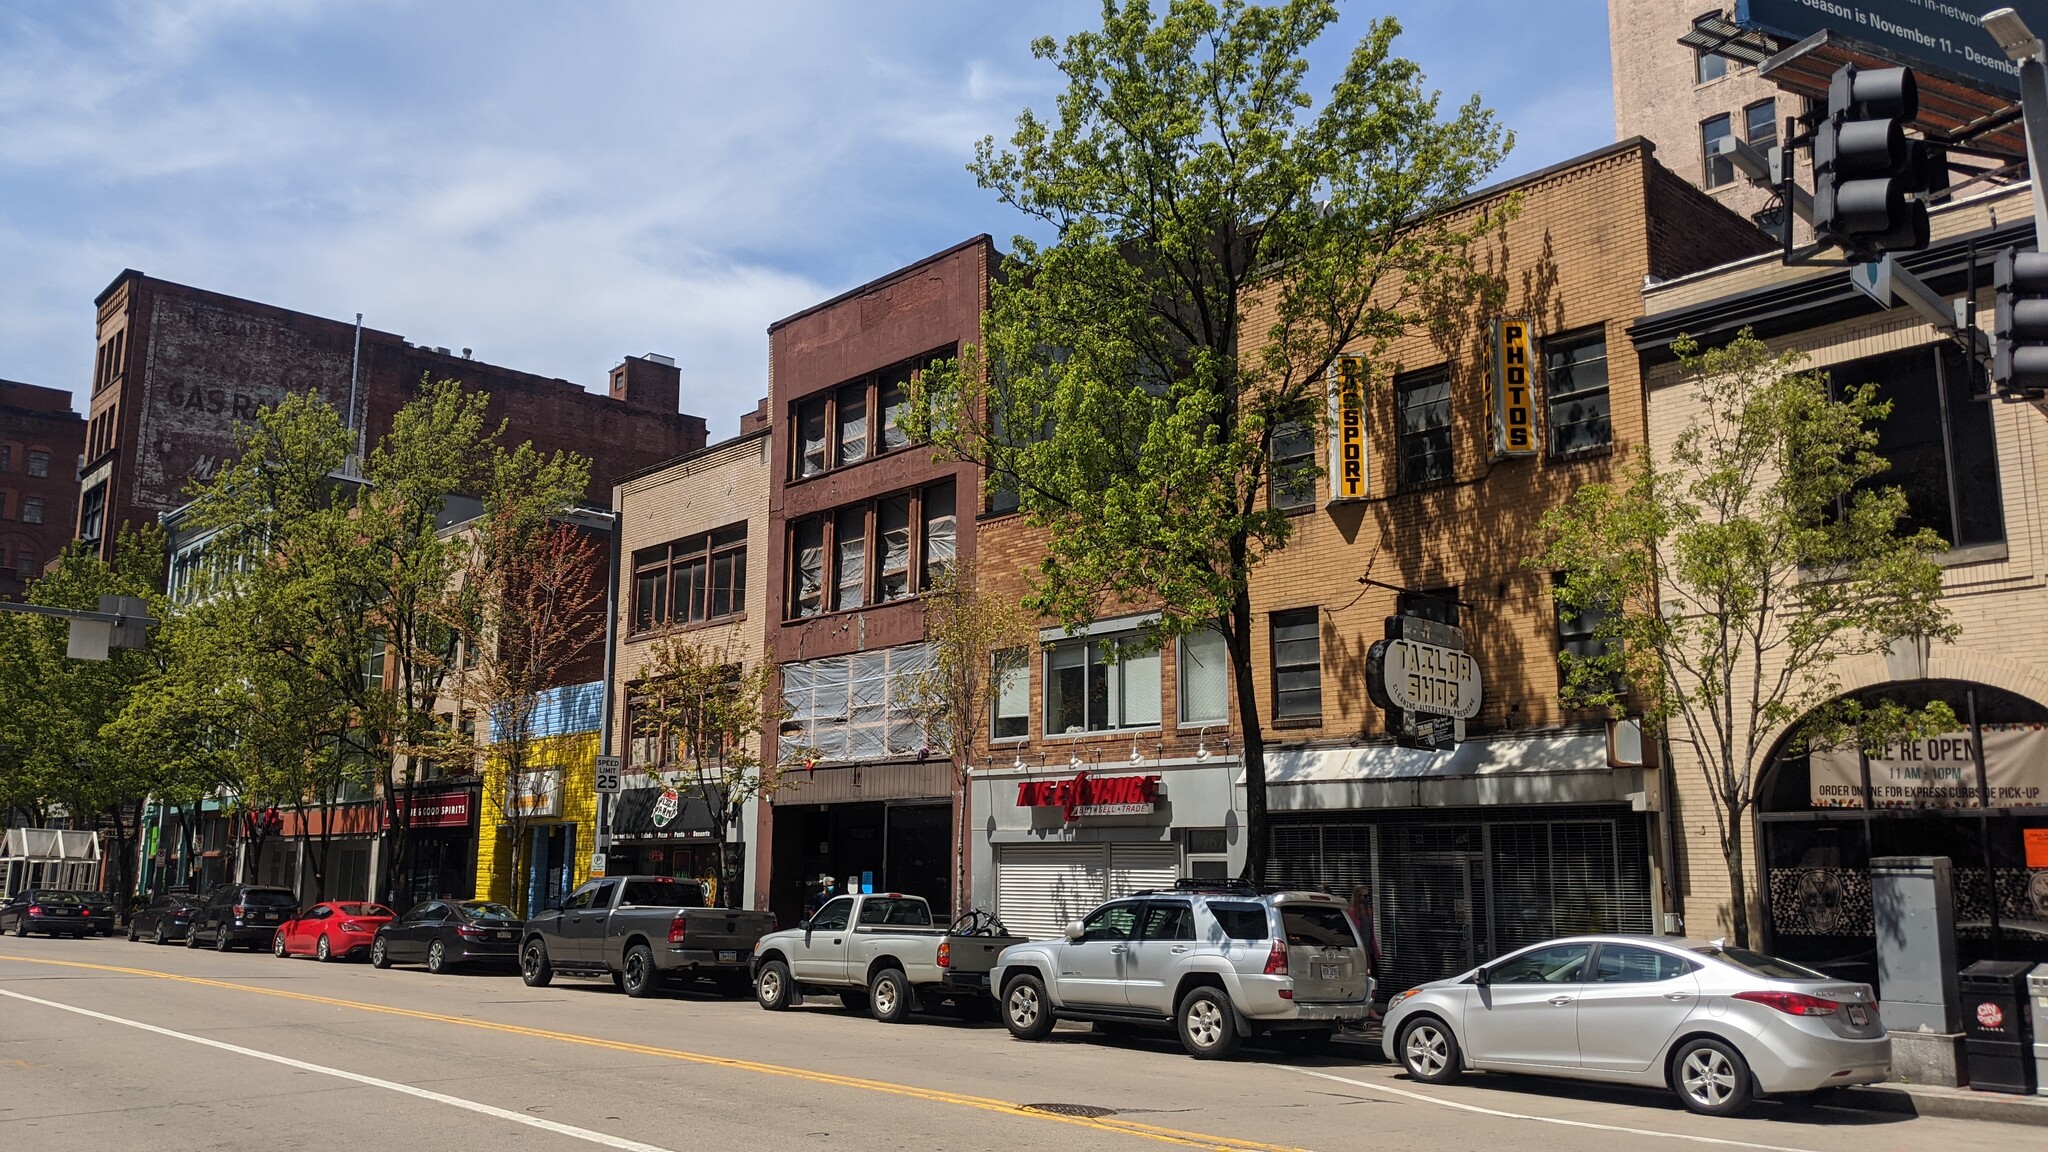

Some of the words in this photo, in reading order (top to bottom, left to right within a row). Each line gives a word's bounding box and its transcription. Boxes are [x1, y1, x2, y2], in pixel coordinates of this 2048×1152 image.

[1855, 8, 1866, 24] is
[1869, 13, 1936, 48] November
[1939, 38, 1952, 53] 11
[1964, 46, 2020, 77] Decembe
[167, 378, 226, 414] GAS
[1505, 326, 1528, 446] PHOTOS
[1341, 359, 1361, 495] PASSPORT
[1396, 641, 1472, 681] TAILOR
[1393, 684, 1416, 710] CLEANING
[1419, 704, 1450, 716] ALTERATION
[1454, 698, 1475, 717] PRESSING
[1408, 674, 1459, 708] SHOP
[1868, 739, 1923, 760] WERE
[597, 775, 618, 789] 25
[1890, 767, 1901, 779] 11
[1905, 767, 1920, 779] AM
[1933, 767, 1961, 779] 10PM
[1016, 781, 1056, 806] THE
[1820, 785, 1850, 796] ORDER
[1851, 786, 1883, 797] ONNE
[1885, 787, 1903, 797] FOR
[1905, 787, 1947, 798] EXPRESS
[1949, 787, 1996, 798] CURBSDE
[1999, 787, 2040, 799] PICK-UP
[423, 806, 439, 816] GOOD
[441, 805, 465, 815] SPIRITS
[1099, 806, 1116, 814] SELL
[1122, 805, 1146, 813] TRADE
[1977, 1004, 1996, 1016] City
